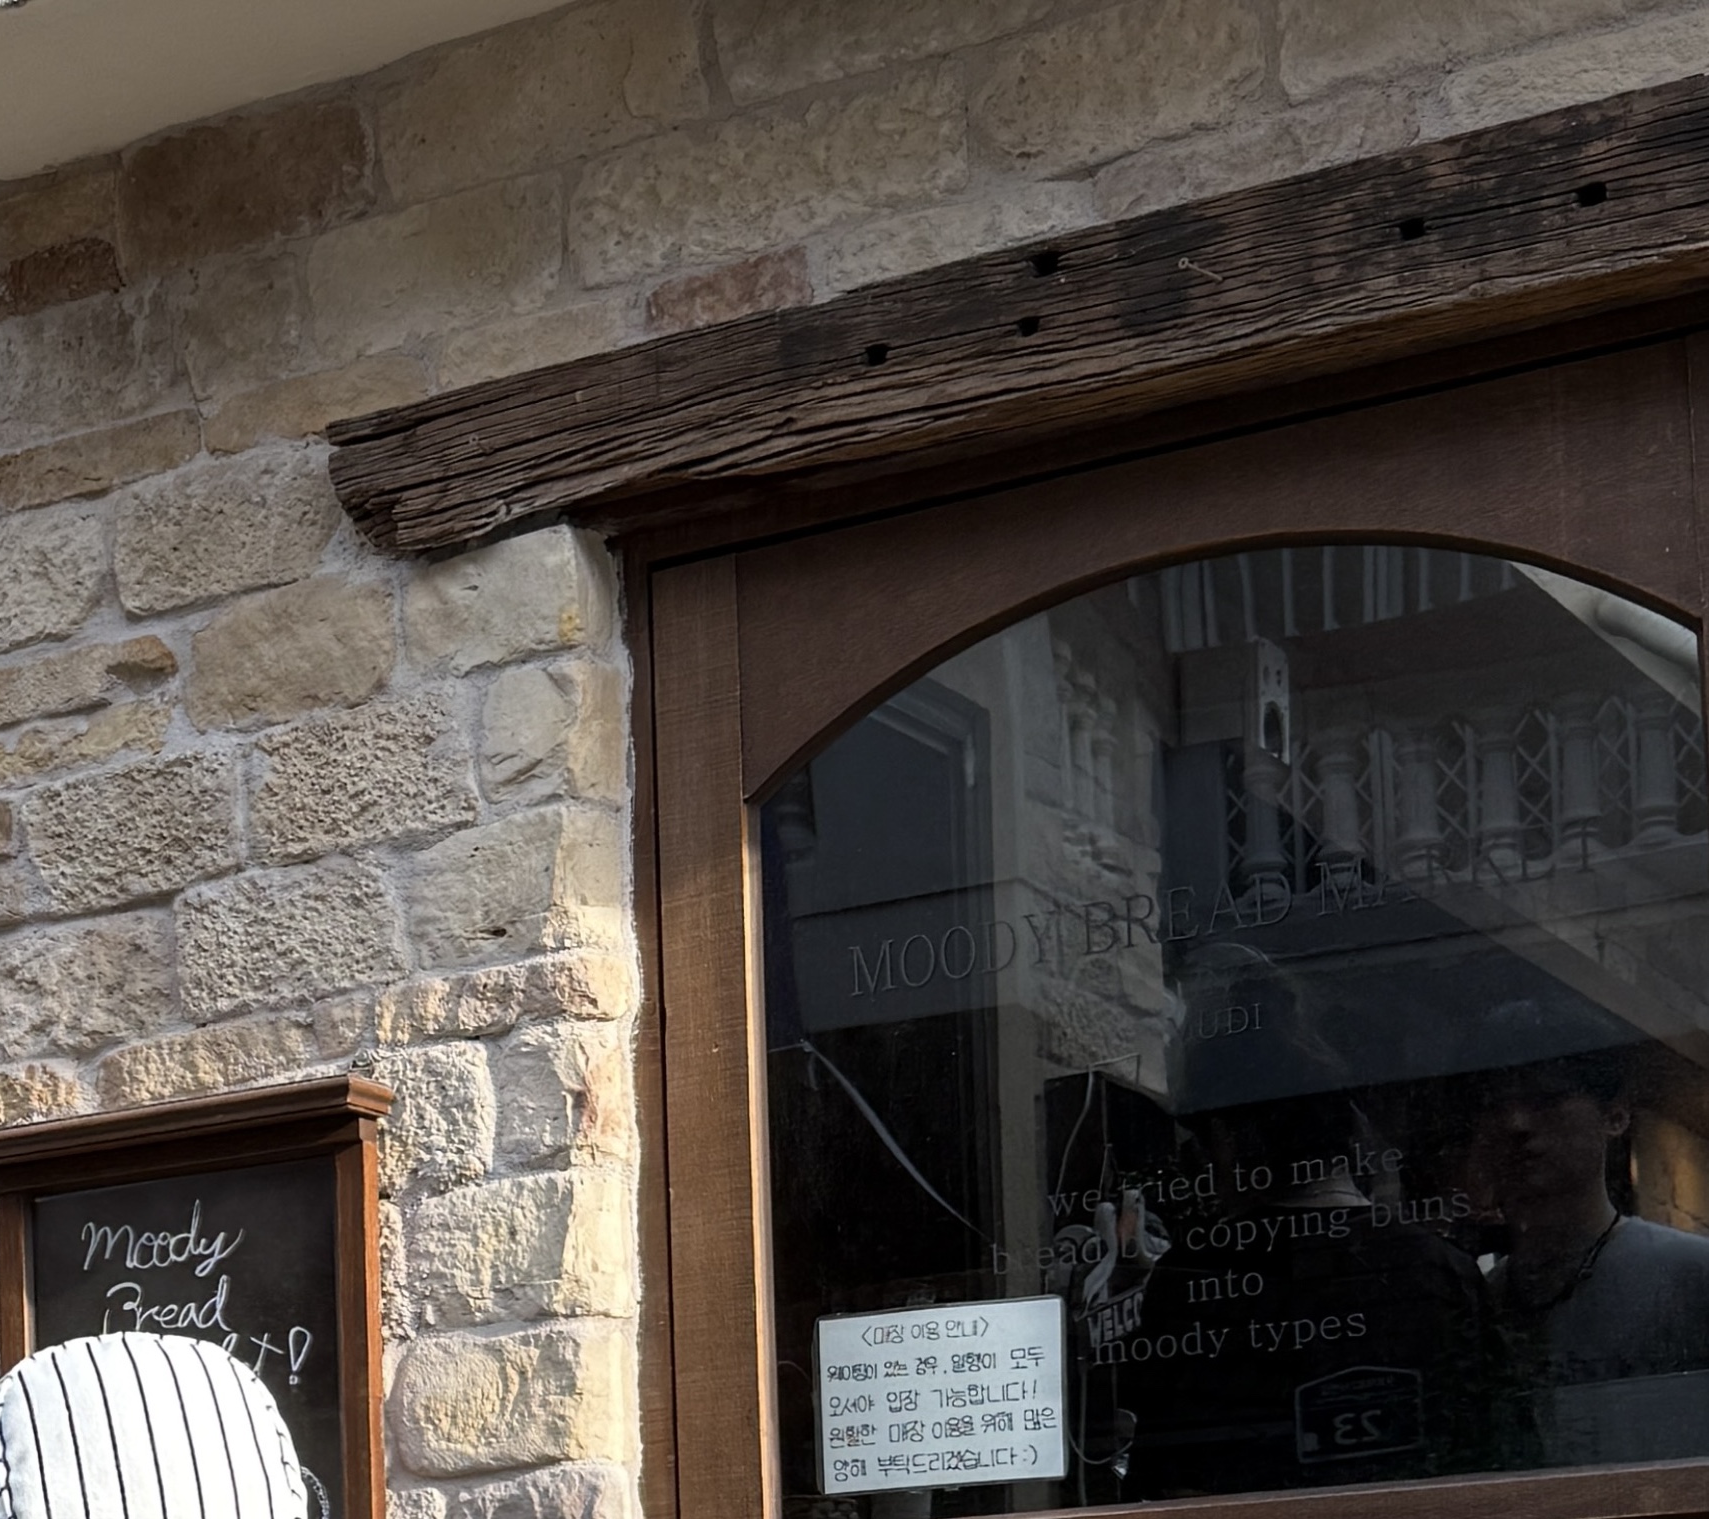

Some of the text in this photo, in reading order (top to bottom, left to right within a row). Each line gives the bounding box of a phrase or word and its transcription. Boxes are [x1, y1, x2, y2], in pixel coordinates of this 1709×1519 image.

[848, 911, 1061, 997] MOODY
[1082, 871, 1292, 956] BREAD
[1047, 1185, 1102, 1219] we
[1233, 1163, 1273, 1193] to
[1290, 1142, 1405, 1186] make
[82, 1199, 244, 1277] Moody
[1185, 1206, 1352, 1253] copying
[1371, 1190, 1472, 1229] buns
[102, 1274, 232, 1334] Bread
[1186, 1269, 1265, 1304] into
[911, 1321, 941, 1341] 이용
[1092, 1311, 1368, 1368] moody types
[883, 1359, 910, 1378] 있는
[1010, 1346, 1045, 1369] 모두
[886, 1389, 921, 1413] 입장
[889, 1419, 926, 1443] 매장
[1024, 1406, 1058, 1431] 많은
[833, 1458, 867, 1483] 양해
